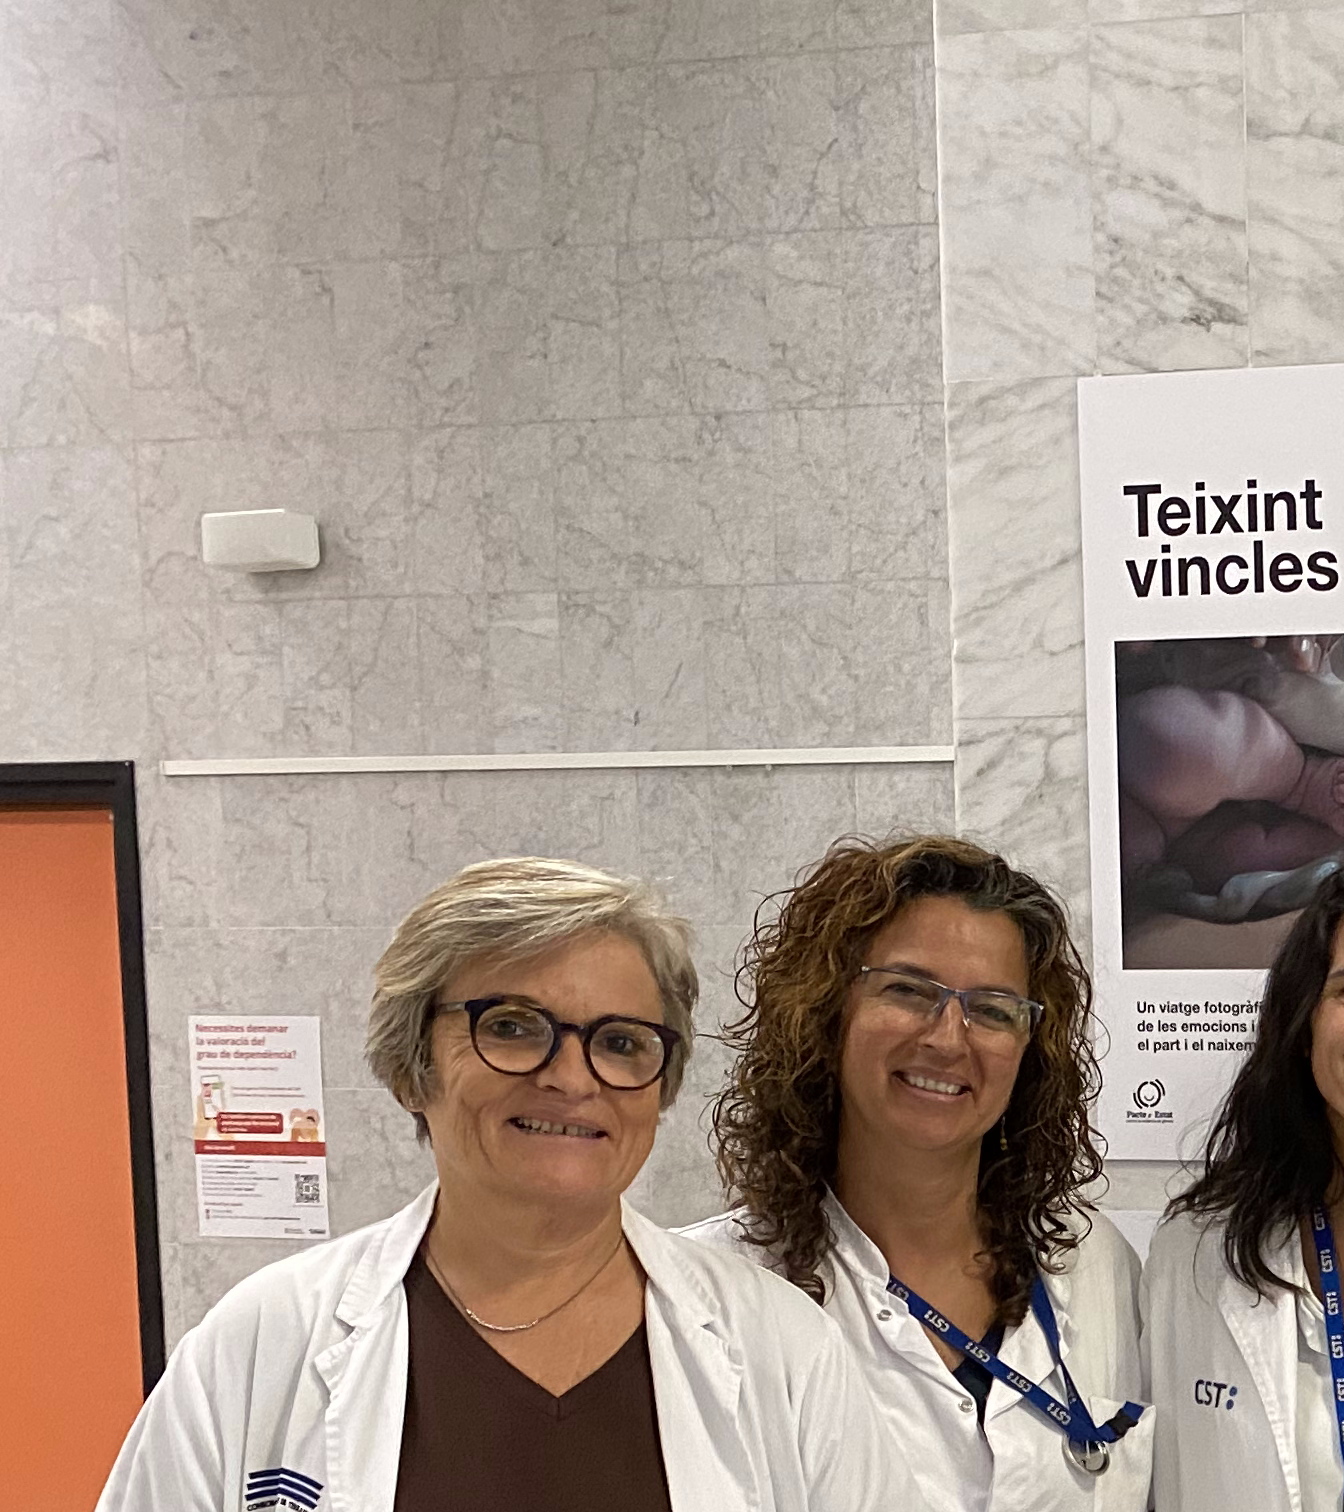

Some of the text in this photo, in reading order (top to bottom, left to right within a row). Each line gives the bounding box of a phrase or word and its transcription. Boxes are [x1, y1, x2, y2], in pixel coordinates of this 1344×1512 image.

[1123, 479, 1323, 537] Teixint
[1125, 540, 1338, 598] vincles
[1137, 1000, 1259, 1016] Un viatge fotogràf
[1137, 1020, 1255, 1032] de les emocions i
[1138, 1039, 1257, 1053] el part i el naixem
